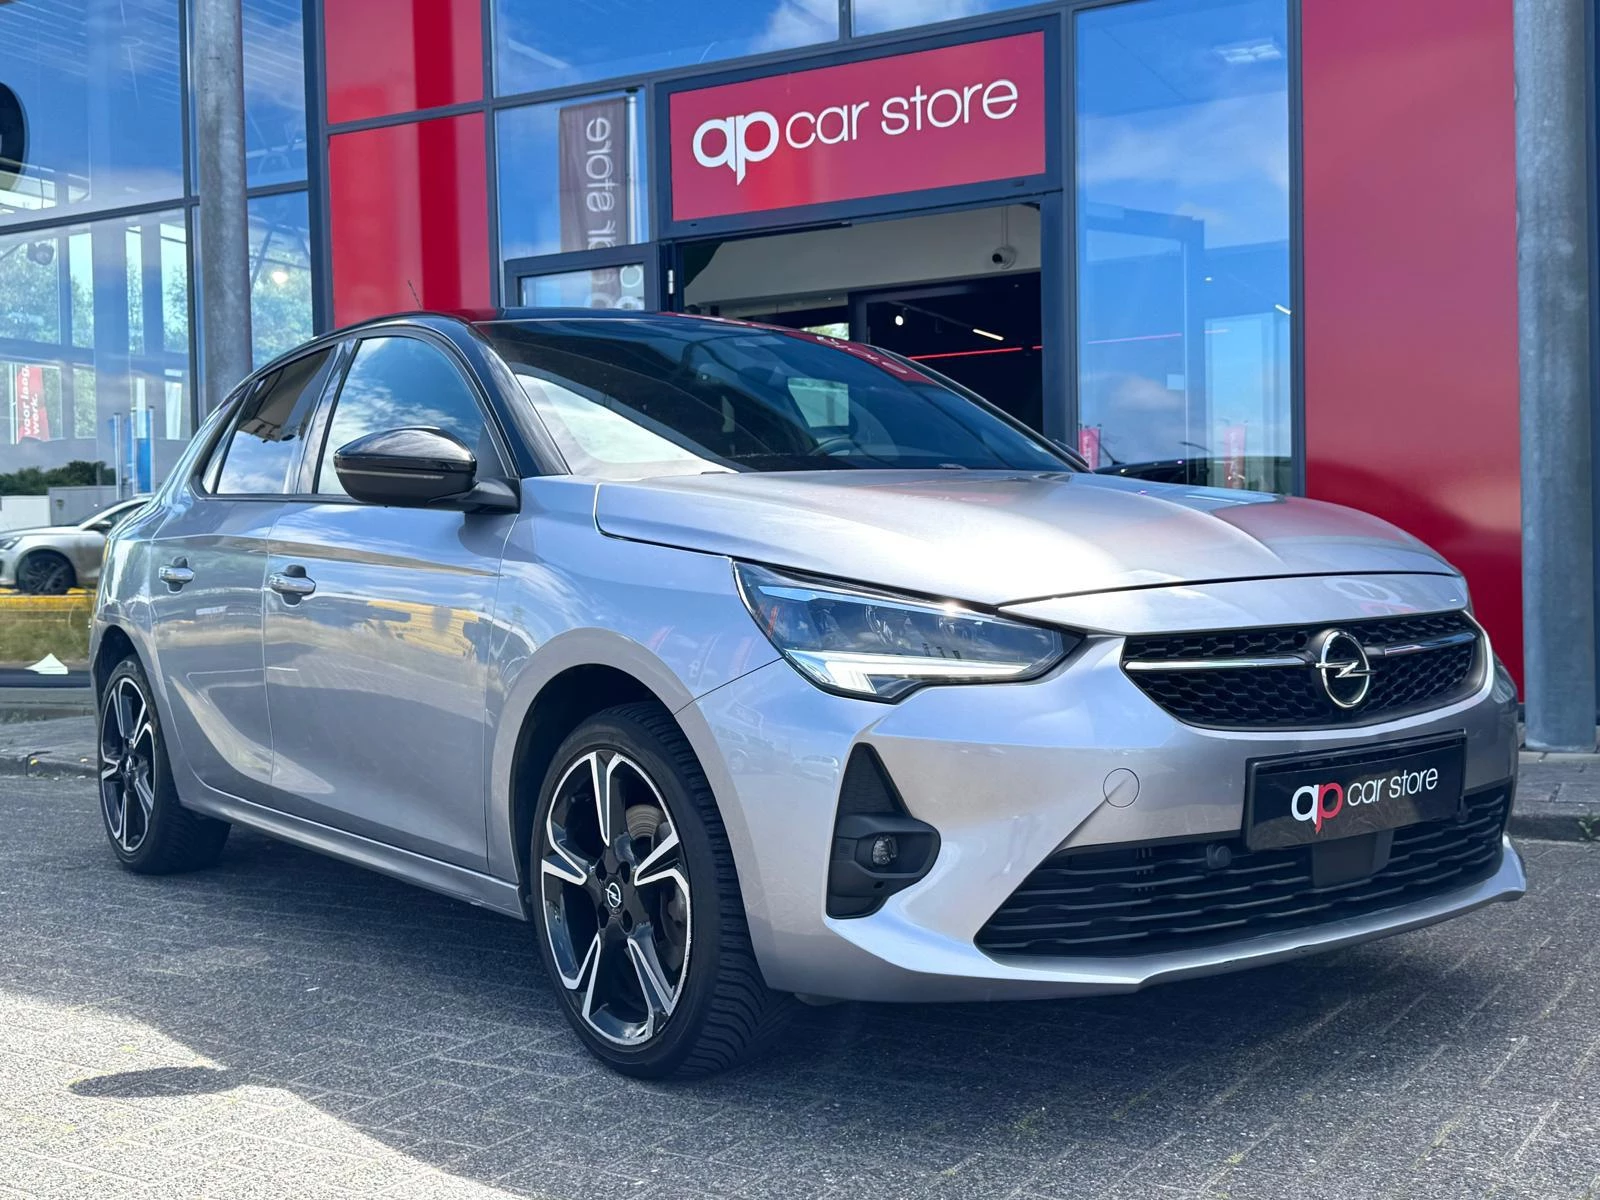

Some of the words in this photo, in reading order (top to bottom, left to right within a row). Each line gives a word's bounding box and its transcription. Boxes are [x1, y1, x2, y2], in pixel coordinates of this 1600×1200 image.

[692, 111, 780, 186] ap
[785, 101, 870, 149] car
[881, 79, 1018, 135] store
[1291, 782, 1344, 834] ap
[1347, 778, 1387, 806] car
[1389, 768, 1438, 798] store
